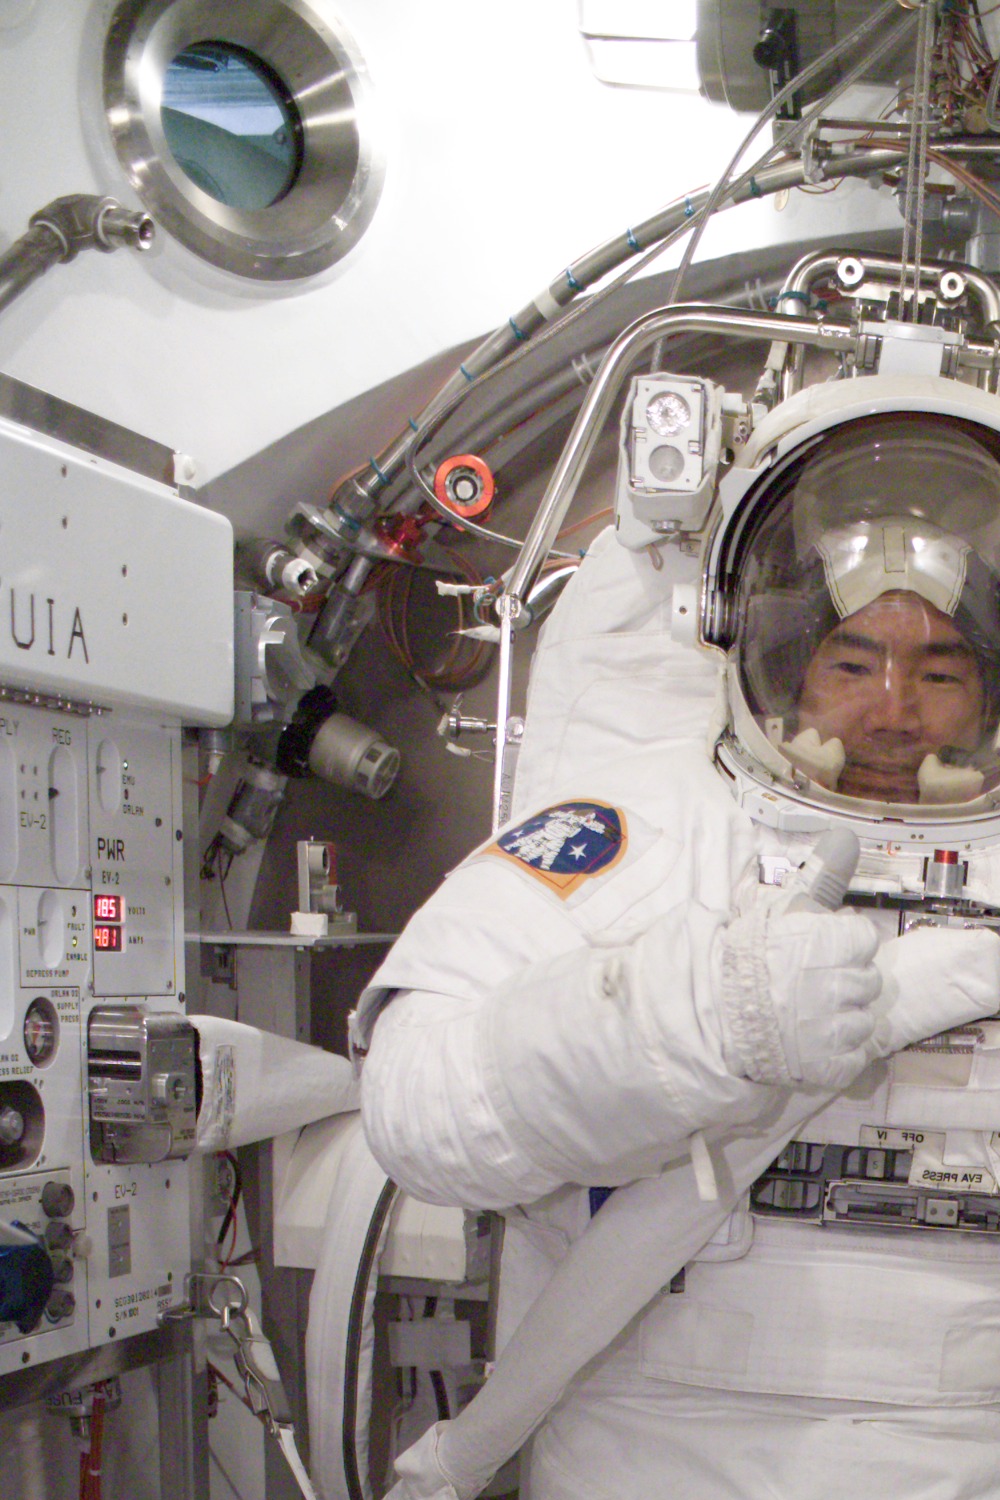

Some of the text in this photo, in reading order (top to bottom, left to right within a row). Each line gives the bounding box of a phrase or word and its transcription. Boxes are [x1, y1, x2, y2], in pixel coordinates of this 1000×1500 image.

[10, 588, 89, 664] UIA
[52, 727, 72, 746] REG
[20, 811, 47, 830] EV-2
[97, 837, 125, 861] PWR
[102, 870, 120, 885] EV-2
[128, 906, 146, 915] VOLTS
[128, 936, 144, 945] AMPS
[57, 1002, 79, 1010] SUPPLY
[61, 1015, 79, 1023] PRESS
[114, 1182, 137, 1199] EV-2
